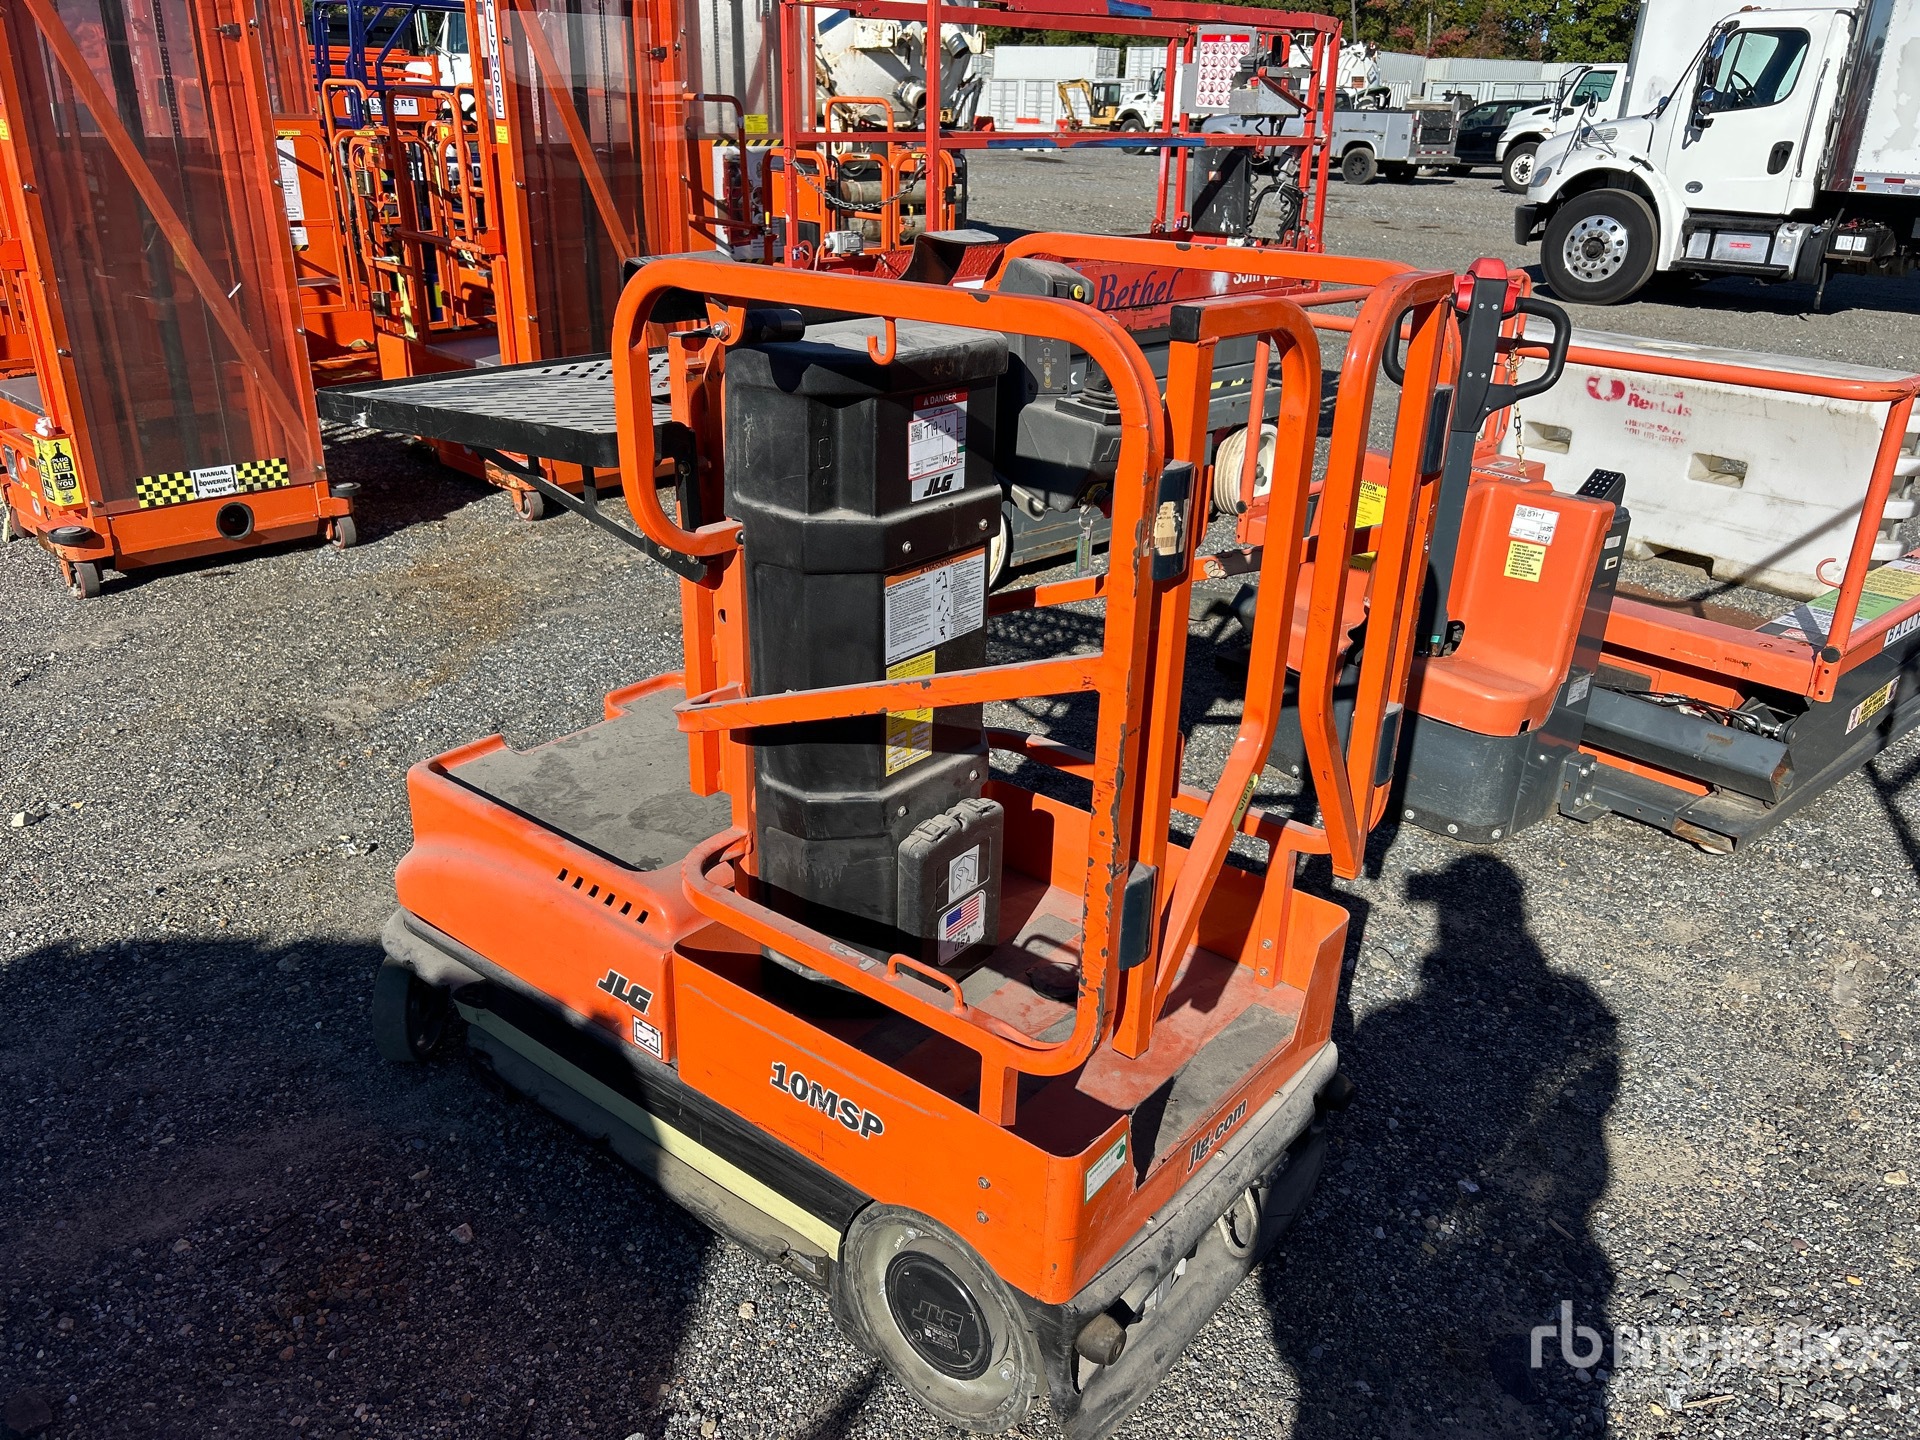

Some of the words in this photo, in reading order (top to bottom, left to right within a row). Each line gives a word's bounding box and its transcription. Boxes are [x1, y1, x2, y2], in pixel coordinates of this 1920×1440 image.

[1096, 268, 1184, 311] Bethel
[930, 392, 957, 404] DANGER
[53, 461, 71, 470] ME
[200, 469, 228, 478] MANUAL
[206, 486, 227, 494] VALVE
[922, 473, 954, 497] JLG
[954, 935, 971, 952] USA
[596, 968, 654, 1014] JLG
[769, 1061, 885, 1140] 10MSP
[1186, 1098, 1248, 1175] jlg.com
[911, 1299, 964, 1335] JLG
